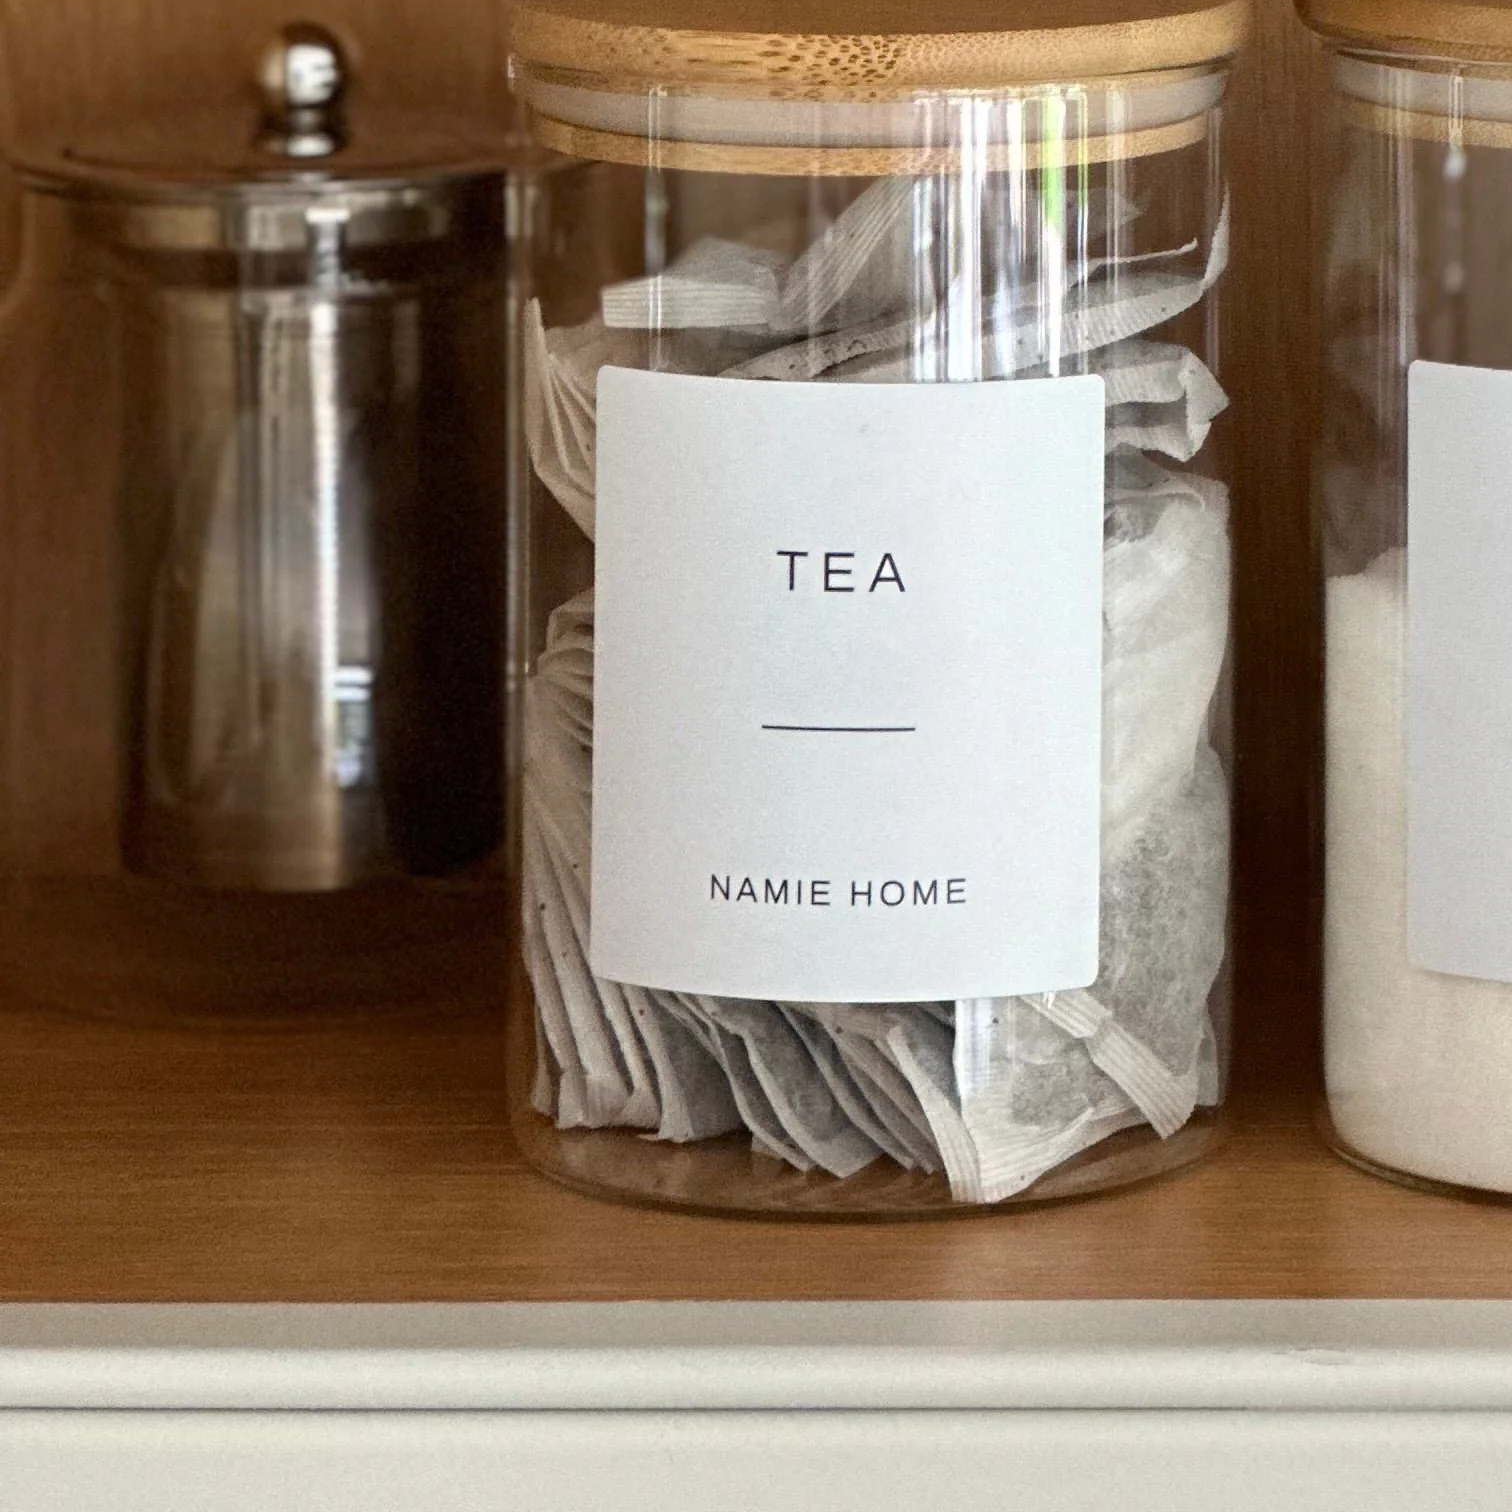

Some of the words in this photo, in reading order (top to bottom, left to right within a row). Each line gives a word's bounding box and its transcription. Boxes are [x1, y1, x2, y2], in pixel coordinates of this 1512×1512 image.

[776, 549, 906, 593] TEA
[710, 873, 831, 907] NAMIE
[850, 877, 967, 908] HOME
